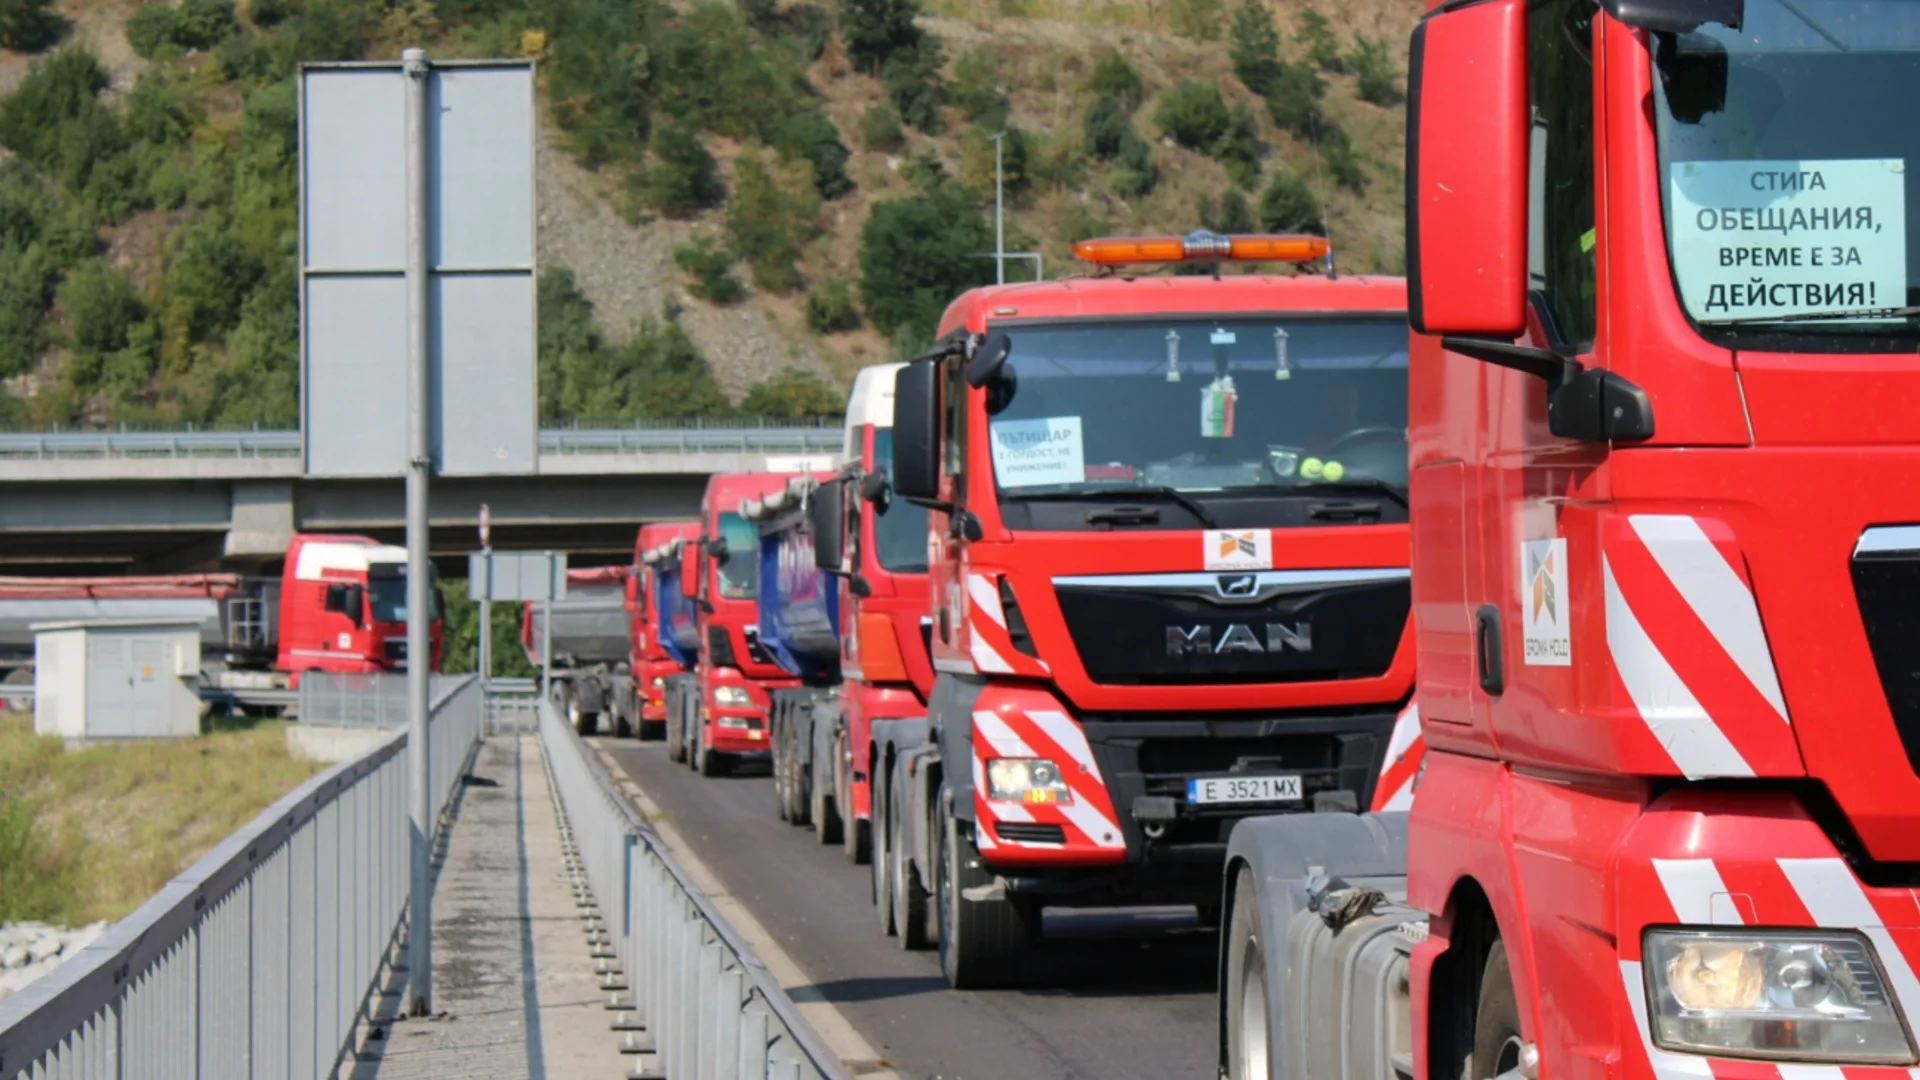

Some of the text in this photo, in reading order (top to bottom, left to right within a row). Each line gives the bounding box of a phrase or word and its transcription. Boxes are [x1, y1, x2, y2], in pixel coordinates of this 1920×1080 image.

[1751, 171, 1826, 191] СТИГА
[1696, 206, 1882, 236] ОБЕЩАНИЯ,
[1719, 246, 1862, 267] ВРЕМЕ Е ЗА
[1705, 277, 1876, 312] ДЕЙСТВИЯ!
[998, 429, 1072, 444] ПЪТИЩАР
[1165, 622, 1313, 655] MAN
[1206, 782, 1217, 799] E
[1227, 780, 1269, 798] 3521
[1274, 779, 1297, 796] MX
